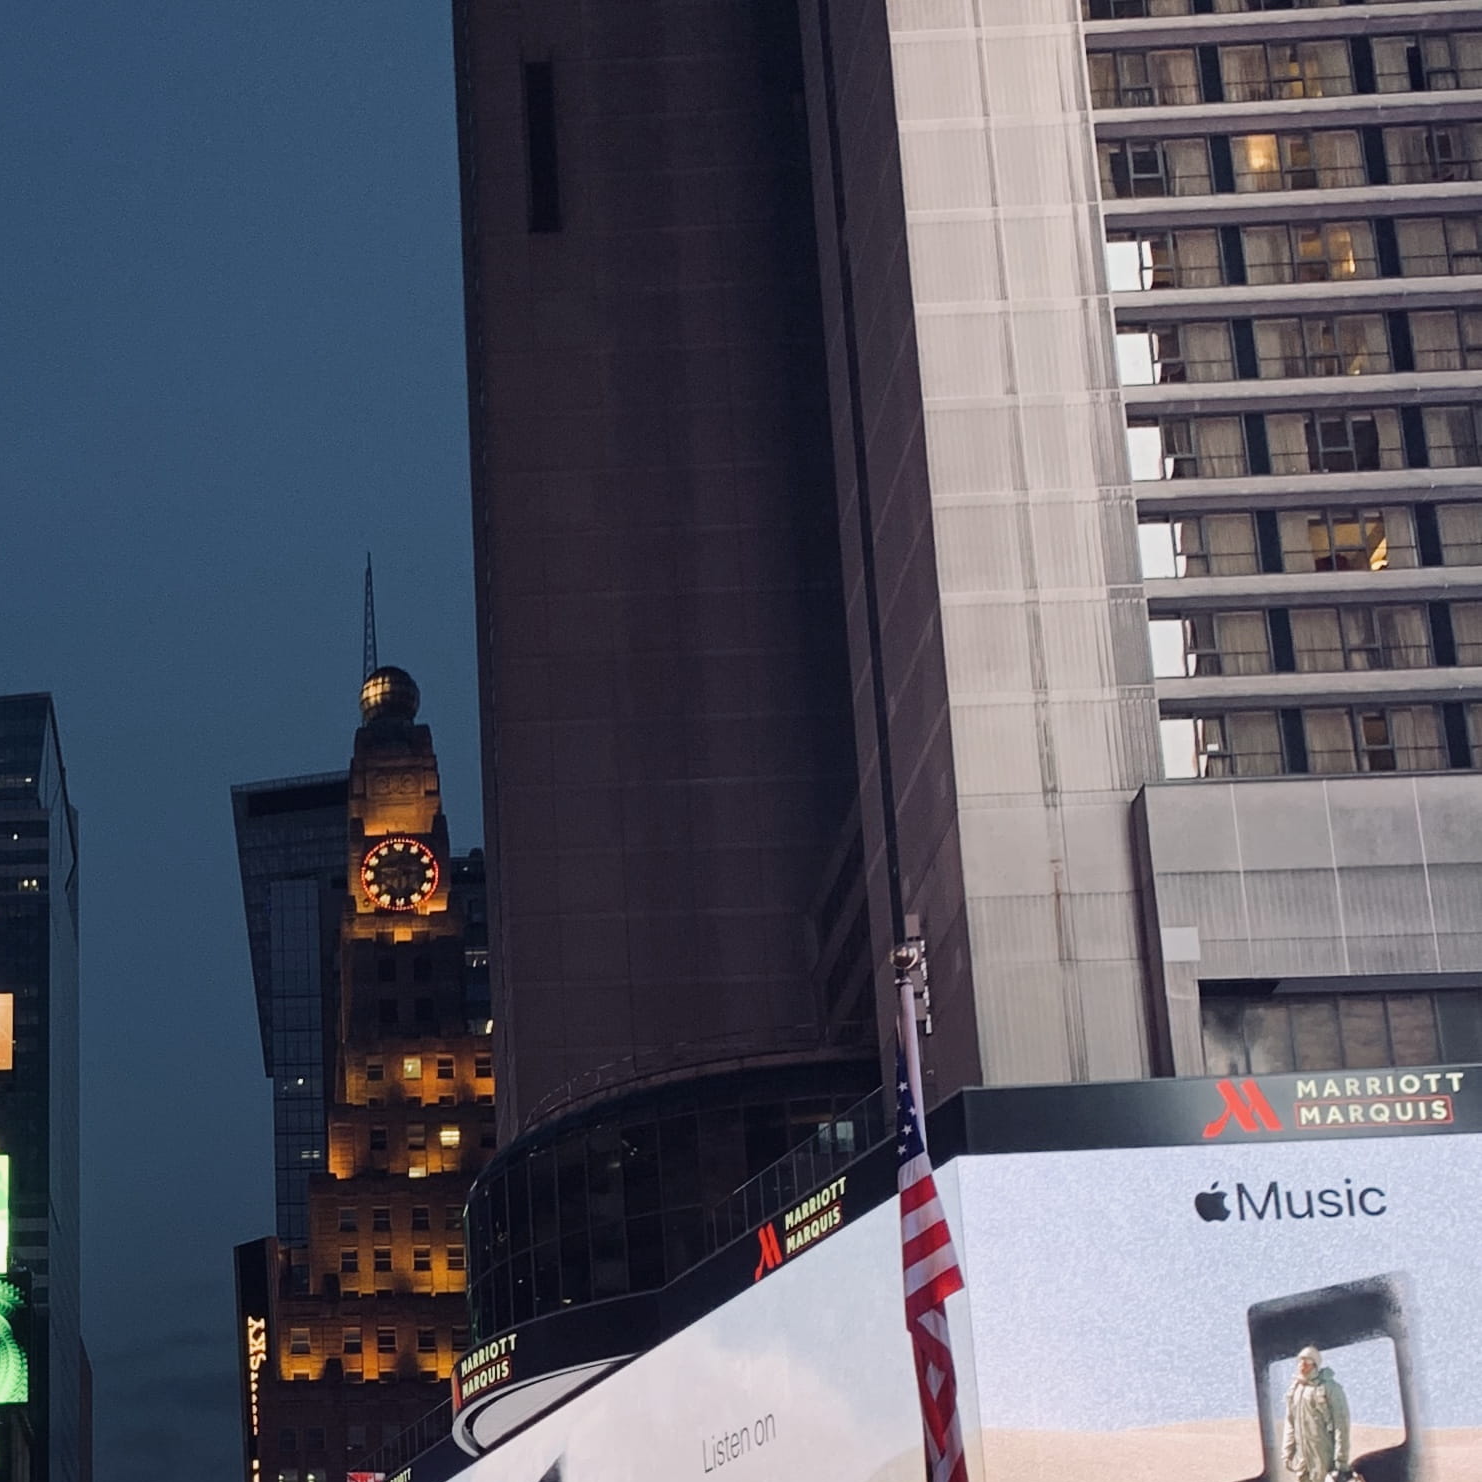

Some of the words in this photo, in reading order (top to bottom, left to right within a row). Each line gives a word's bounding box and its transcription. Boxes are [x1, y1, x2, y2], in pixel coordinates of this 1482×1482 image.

[1297, 1072, 1464, 1098] MARRIOTT
[1299, 1100, 1449, 1126] MARQUIS
[784, 1176, 846, 1231] MARRIOTT
[1236, 1178, 1387, 1223] Music
[786, 1206, 842, 1256] MARQUIS
[461, 1333, 517, 1378] MARRIOTT
[462, 1360, 510, 1400] MARQUIS
[702, 1424, 750, 1474] Listen
[752, 1414, 777, 1449] on
